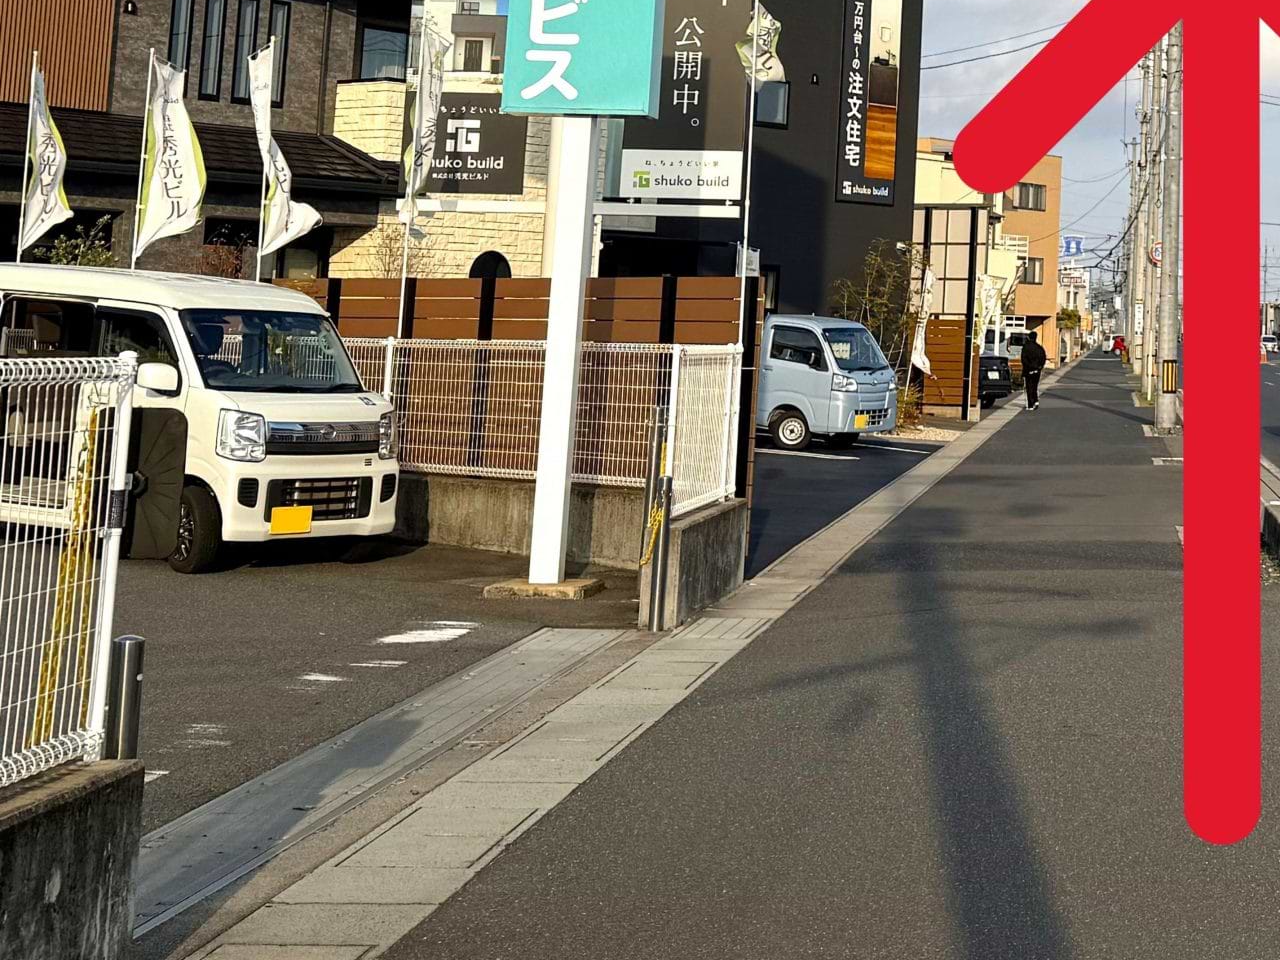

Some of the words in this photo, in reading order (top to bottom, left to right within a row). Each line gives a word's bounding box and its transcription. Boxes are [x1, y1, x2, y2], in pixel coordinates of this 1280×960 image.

[467, 155, 504, 169] build
[654, 175, 692, 187] shuko
[697, 175, 729, 187] build
[852, 184, 871, 195] shuko
